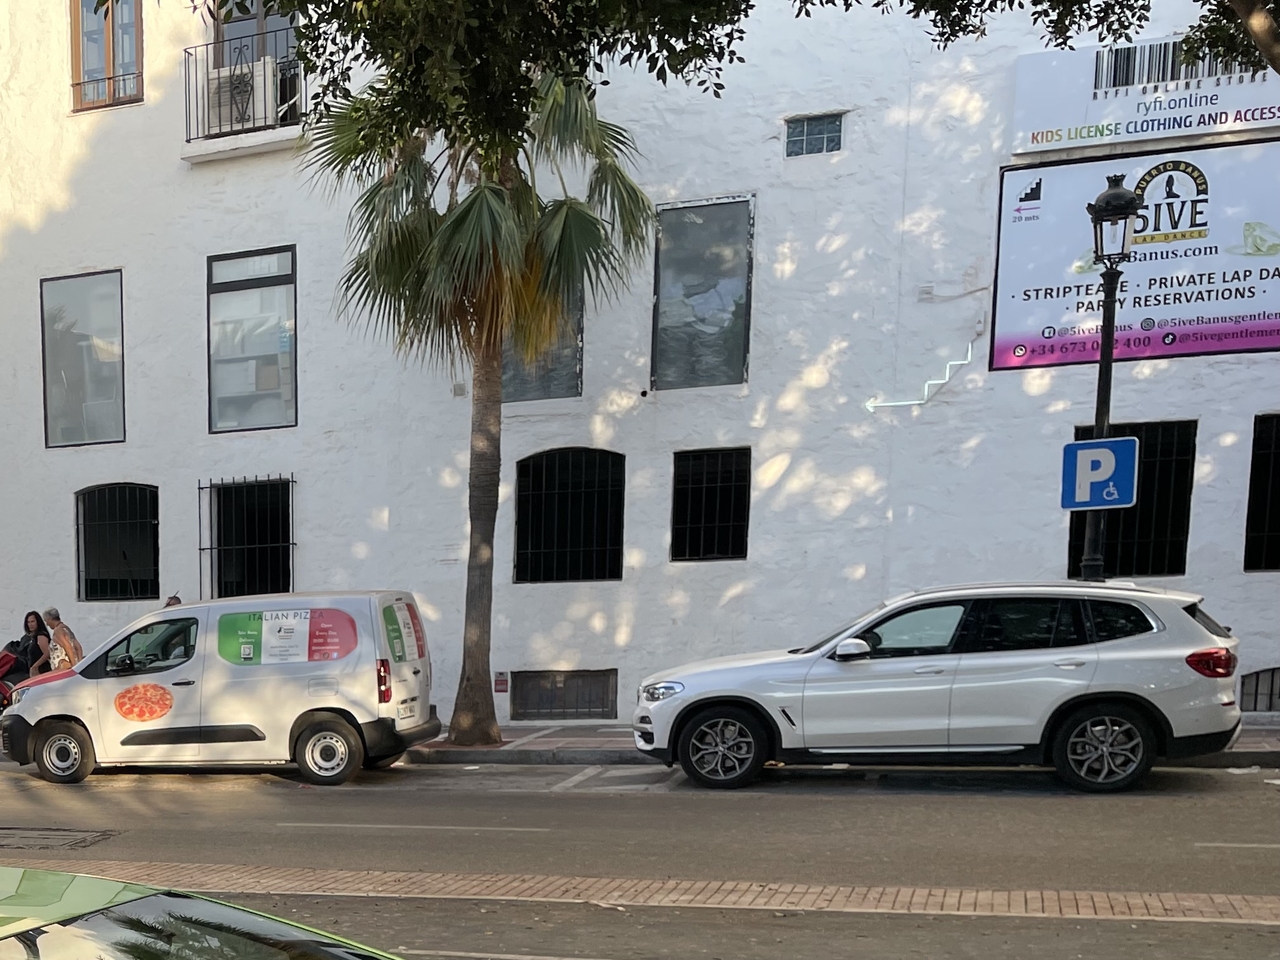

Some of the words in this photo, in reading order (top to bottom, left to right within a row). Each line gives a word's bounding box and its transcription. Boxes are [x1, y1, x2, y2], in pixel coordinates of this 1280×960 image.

[1092, 87, 1129, 100] RYFI
[1142, 79, 1203, 95] ONLINE
[1136, 92, 1219, 117] ryfi.online
[1031, 128, 1063, 145] KIDS
[1067, 122, 1122, 141] LICENSE
[1125, 114, 1193, 135] CLOTHING
[1196, 111, 1229, 127] AND
[1136, 162, 1173, 195] PUERTO
[1179, 162, 1207, 191] BANUS
[1024, 213, 1040, 222] mts
[1133, 198, 1209, 235] 5IVE
[1163, 230, 1205, 241] DANCE
[1022, 280, 1129, 302] STRIPTEAE
[1148, 271, 1216, 290] PRIVATE
[1222, 269, 1253, 284] LAP
[1075, 296, 1125, 314] PARY
[1132, 285, 1256, 309] RESERVATIONS
[1057, 322, 1134, 338] @5iveBnus
[1029, 343, 1055, 356] +34
[1059, 339, 1087, 354] 673
[1090, 338, 1119, 352] 02
[1122, 336, 1152, 350] 400
[1075, 448, 1116, 503] P
[248, 611, 289, 621] ITALIAN
[293, 611, 325, 620] PIZZA
